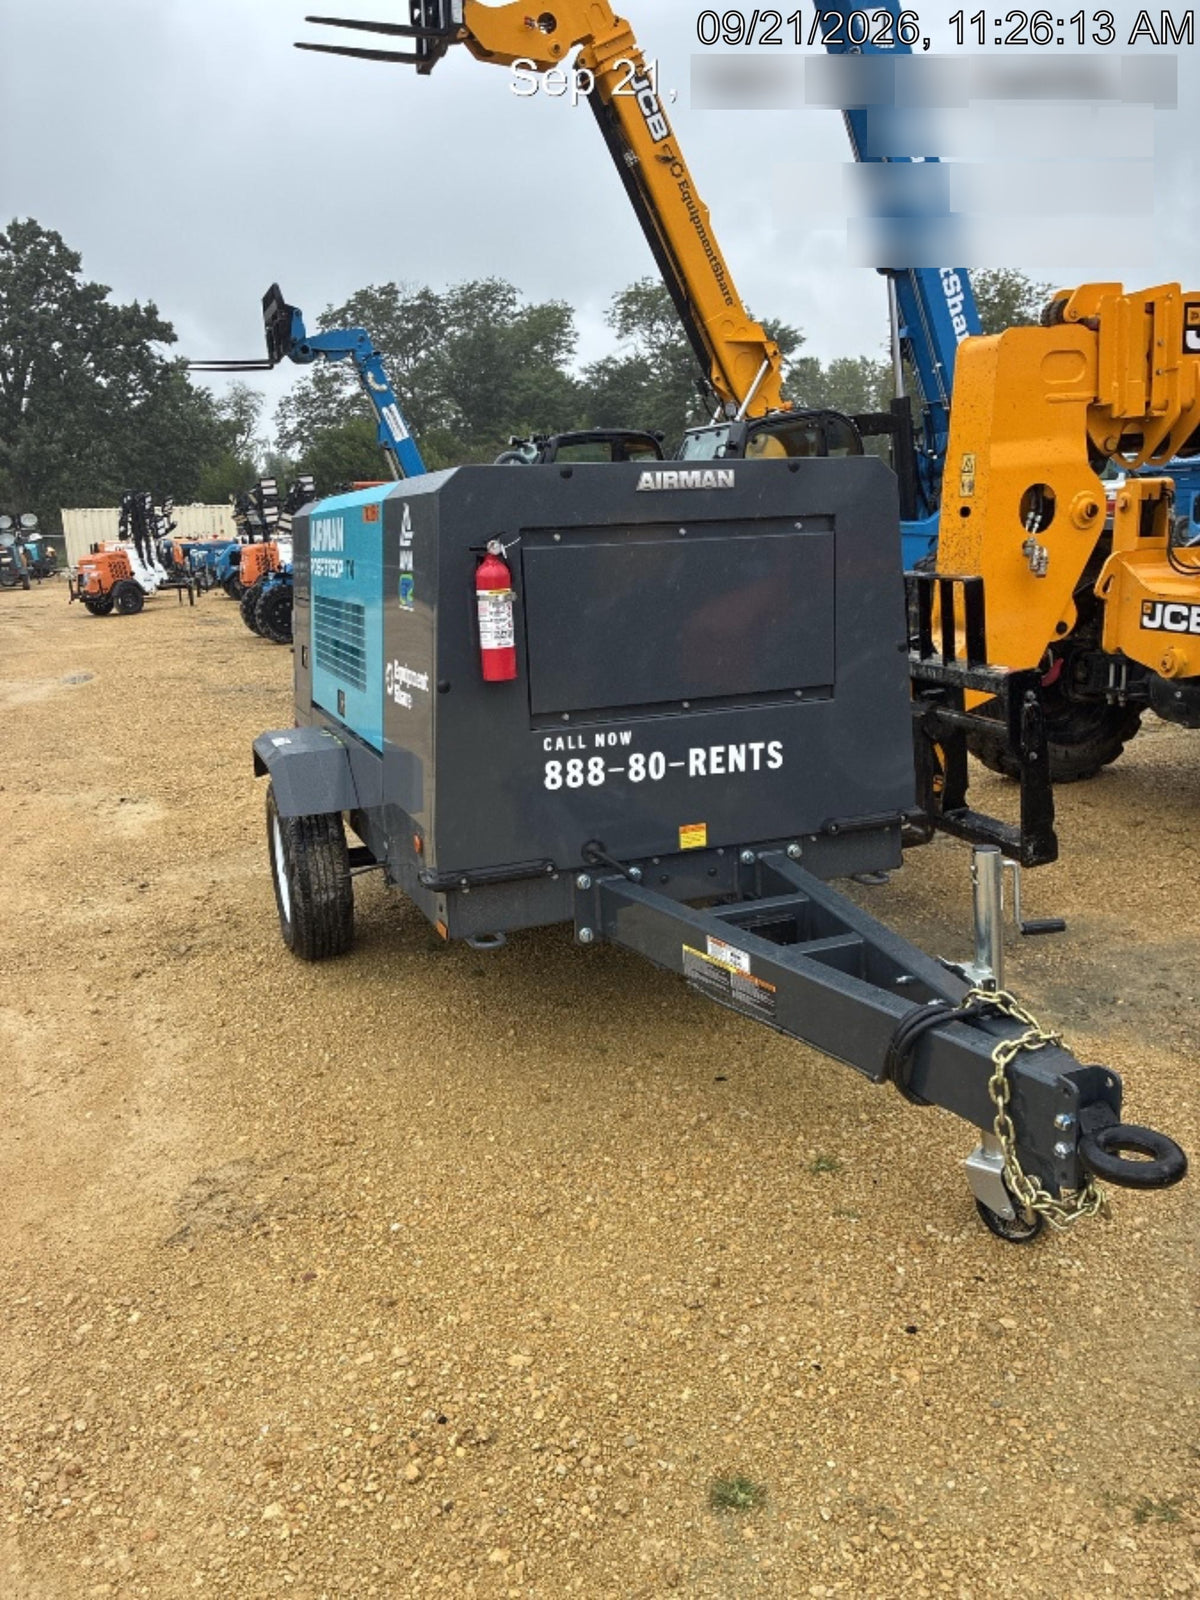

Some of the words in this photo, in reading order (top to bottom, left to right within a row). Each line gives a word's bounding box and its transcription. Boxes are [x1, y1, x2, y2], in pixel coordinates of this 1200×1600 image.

[630, 69, 670, 143] JCB
[678, 178, 735, 307] EquipmentShare
[636, 469, 735, 492] AIRMAN
[543, 735, 587, 751] CALL
[595, 730, 632, 748] NOW
[543, 740, 784, 790] 888-80-RENTS
